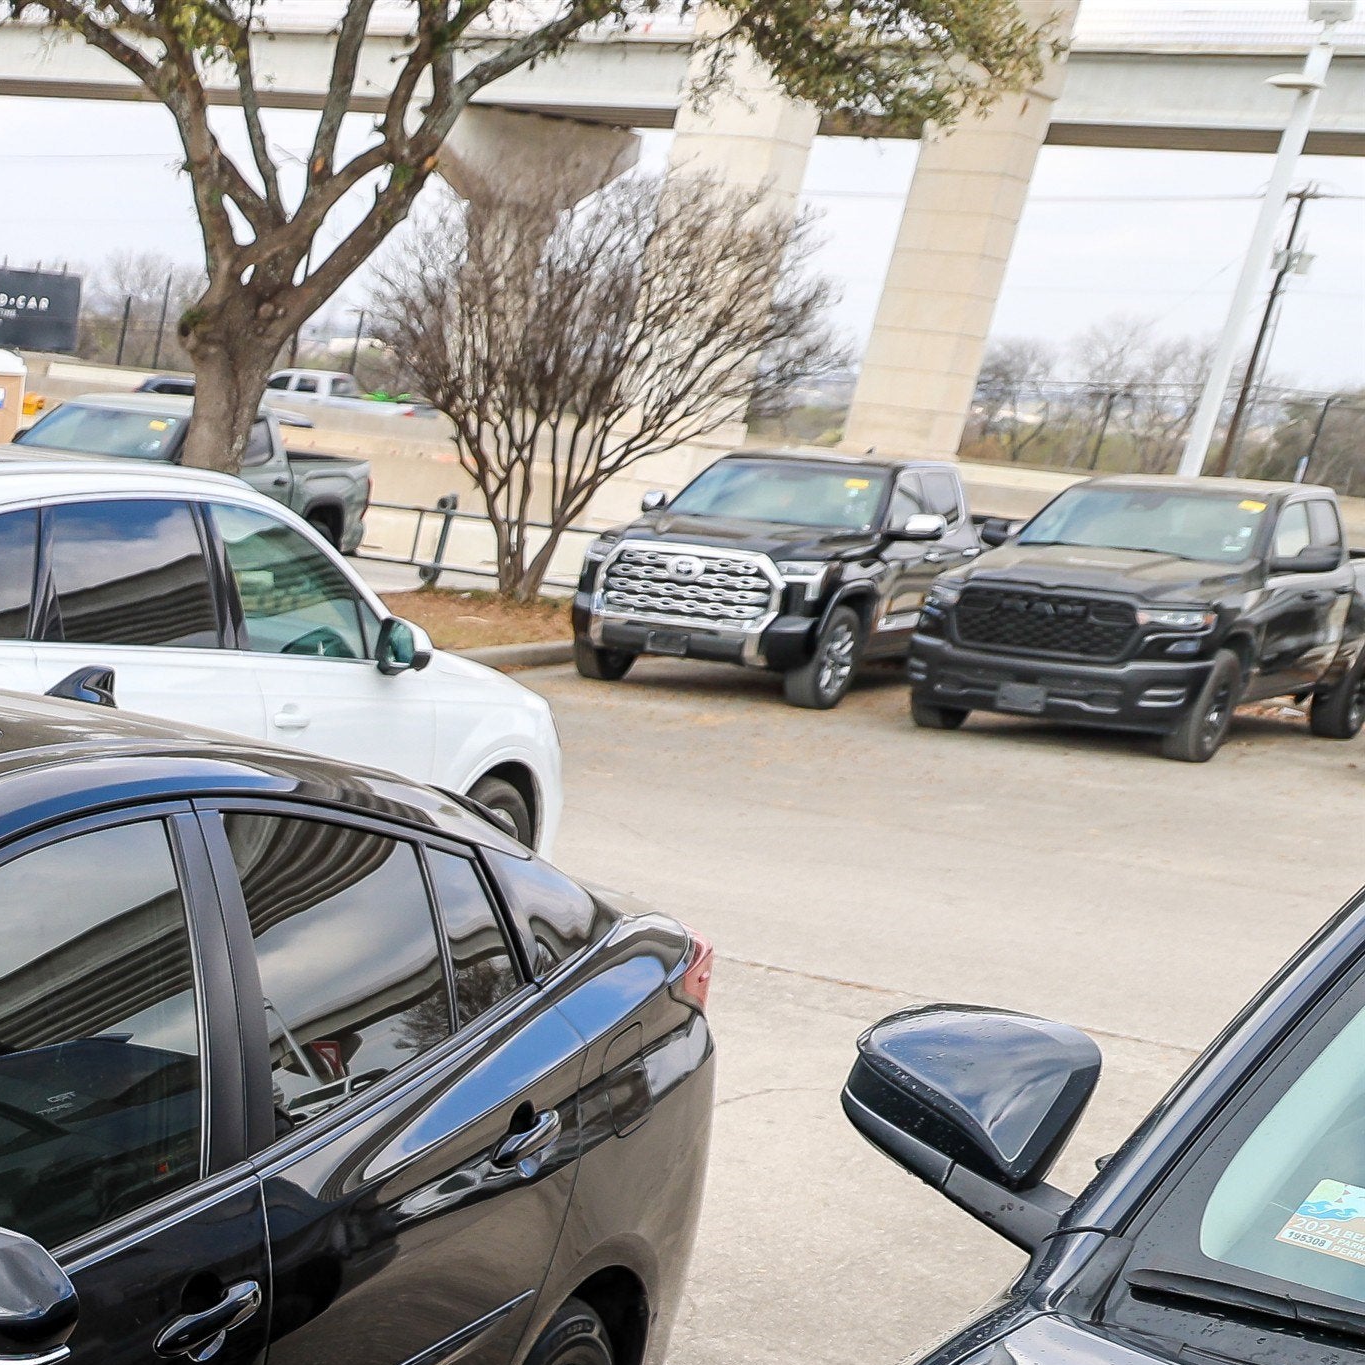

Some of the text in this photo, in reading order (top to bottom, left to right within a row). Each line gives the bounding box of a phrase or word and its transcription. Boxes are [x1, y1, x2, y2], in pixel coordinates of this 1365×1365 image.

[1288, 1231, 1326, 1247] 195308
[1292, 1217, 1365, 1243] 2024 BE
